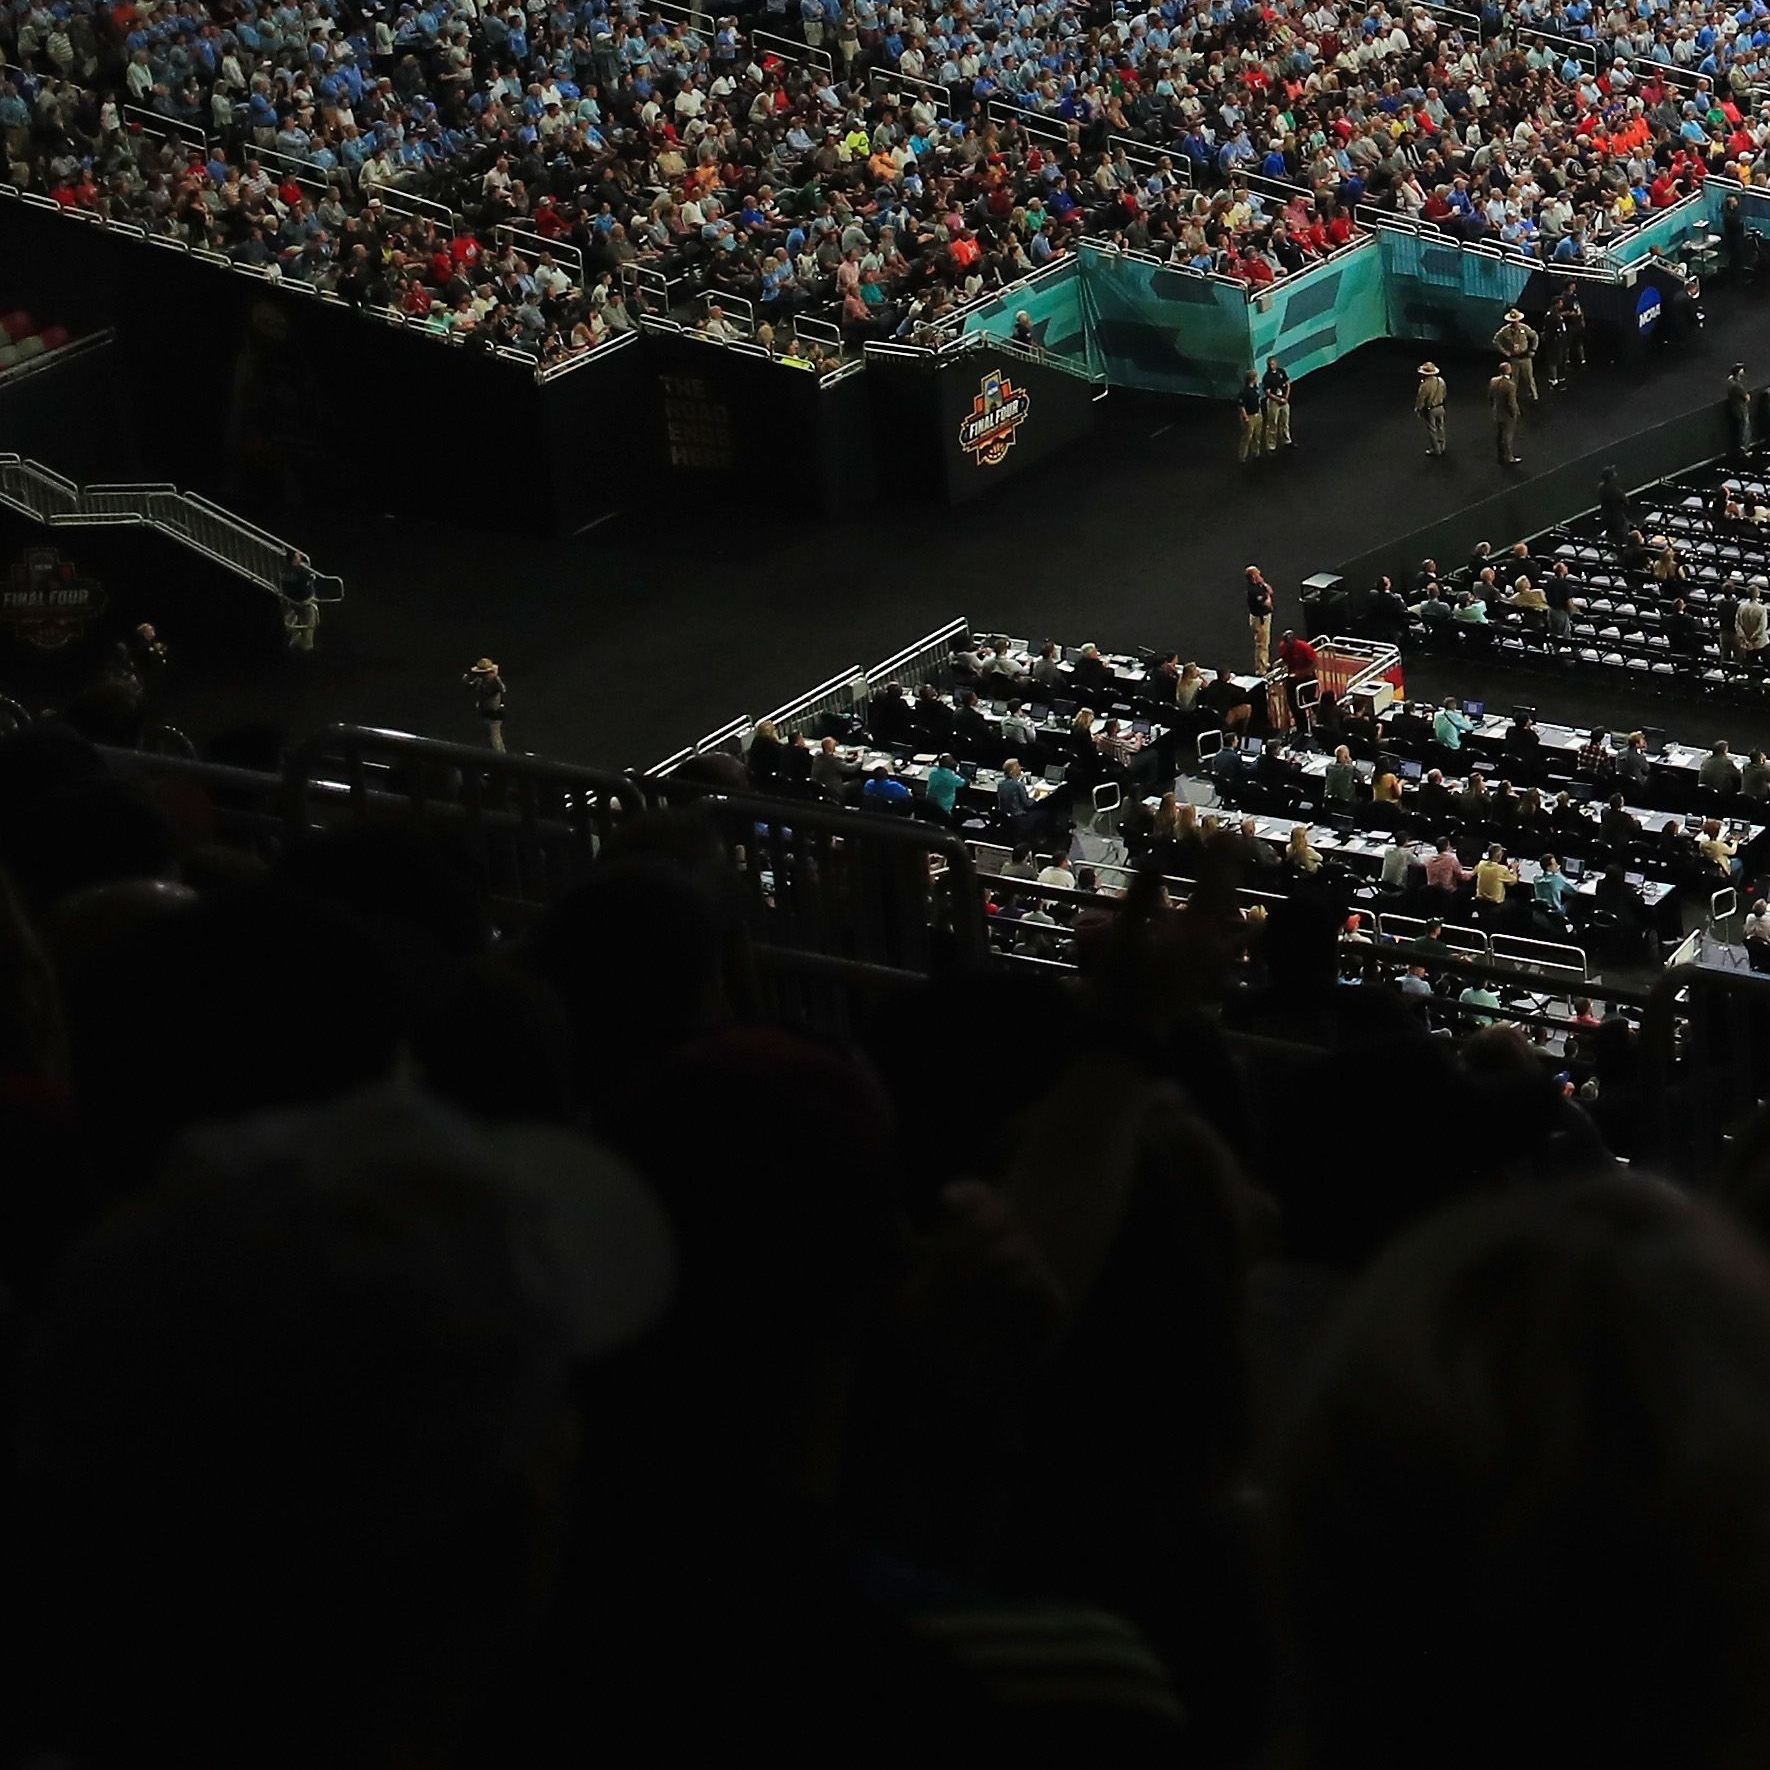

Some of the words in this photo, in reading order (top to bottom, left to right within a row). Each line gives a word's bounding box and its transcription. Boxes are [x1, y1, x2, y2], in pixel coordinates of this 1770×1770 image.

[970, 413, 994, 439] FINAL
[996, 400, 1019, 424] FOUR
[3, 592, 44, 608] FINAL
